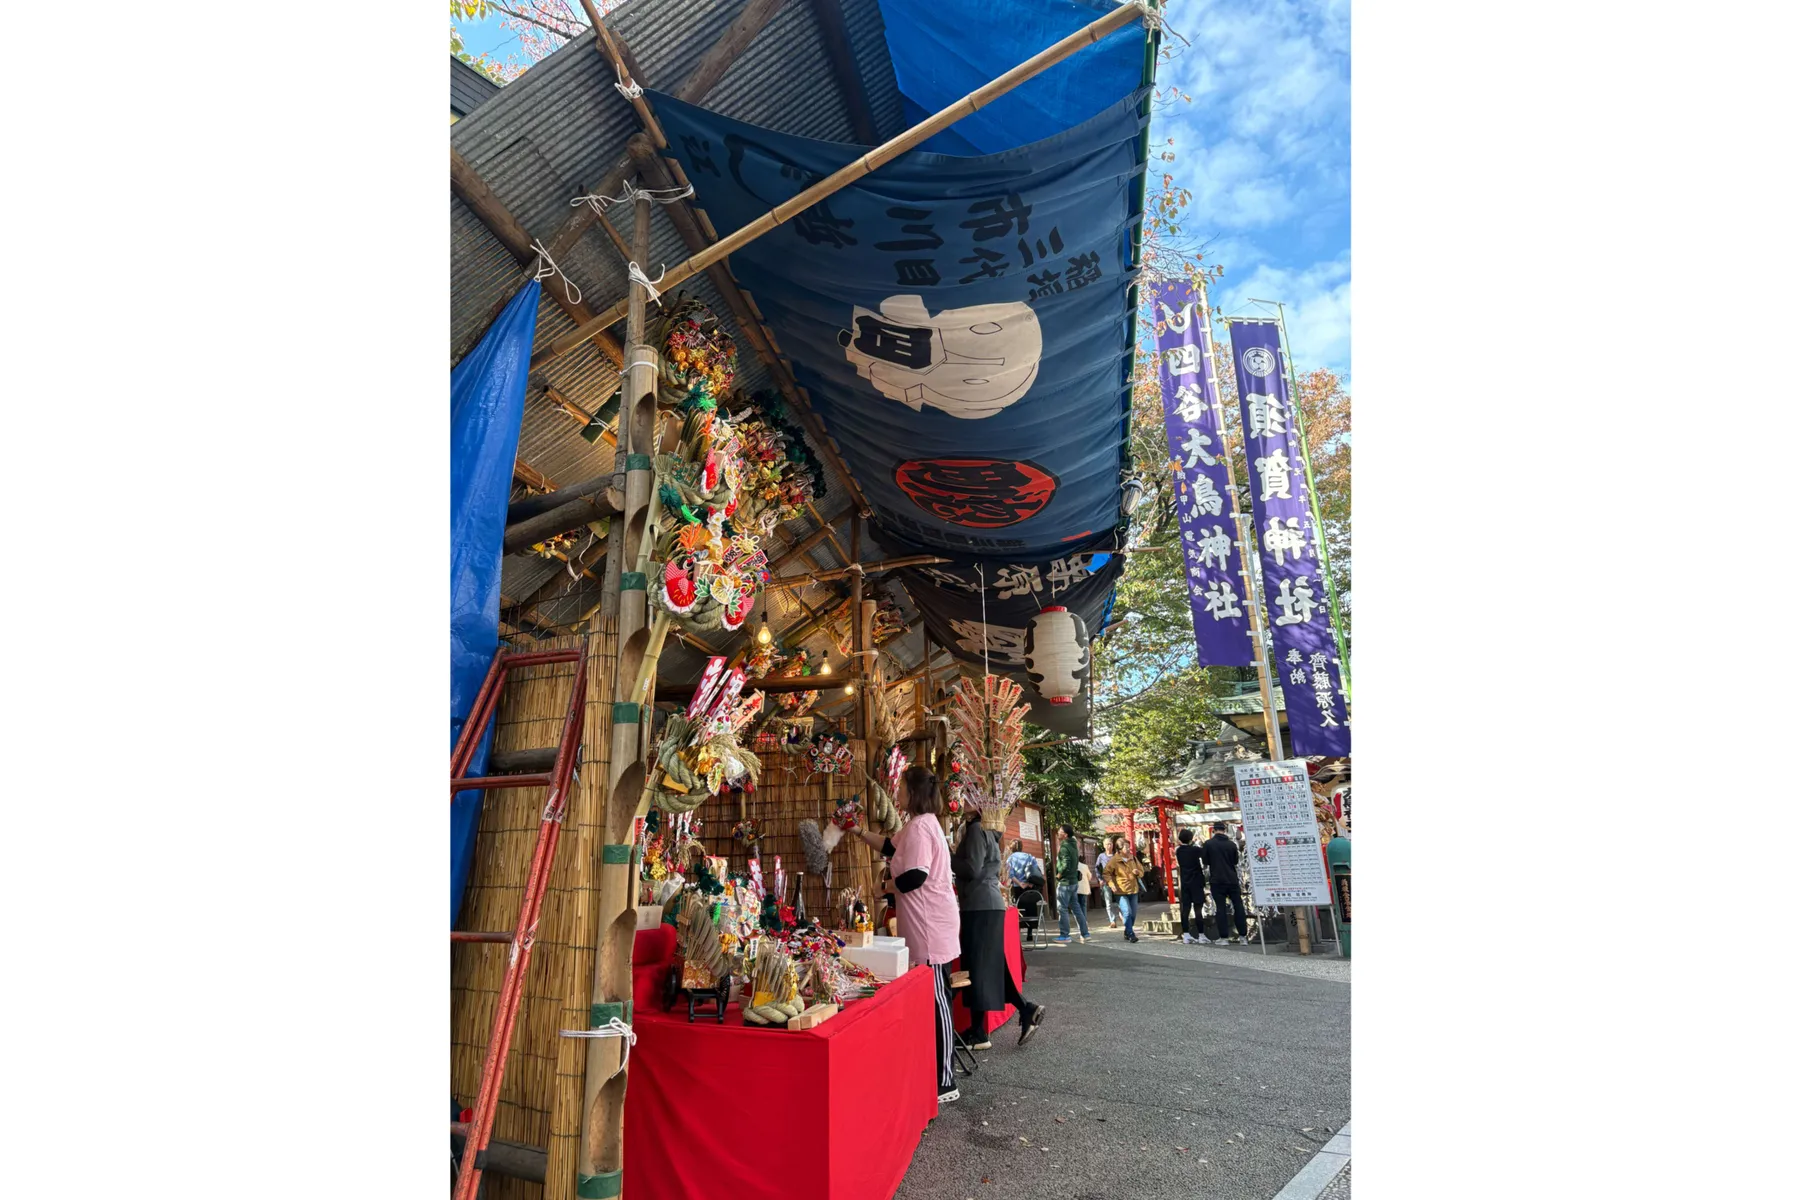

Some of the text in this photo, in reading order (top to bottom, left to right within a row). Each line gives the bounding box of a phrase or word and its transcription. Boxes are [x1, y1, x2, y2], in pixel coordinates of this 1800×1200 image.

[1168, 345, 1243, 622] 四谷大鳥神社
